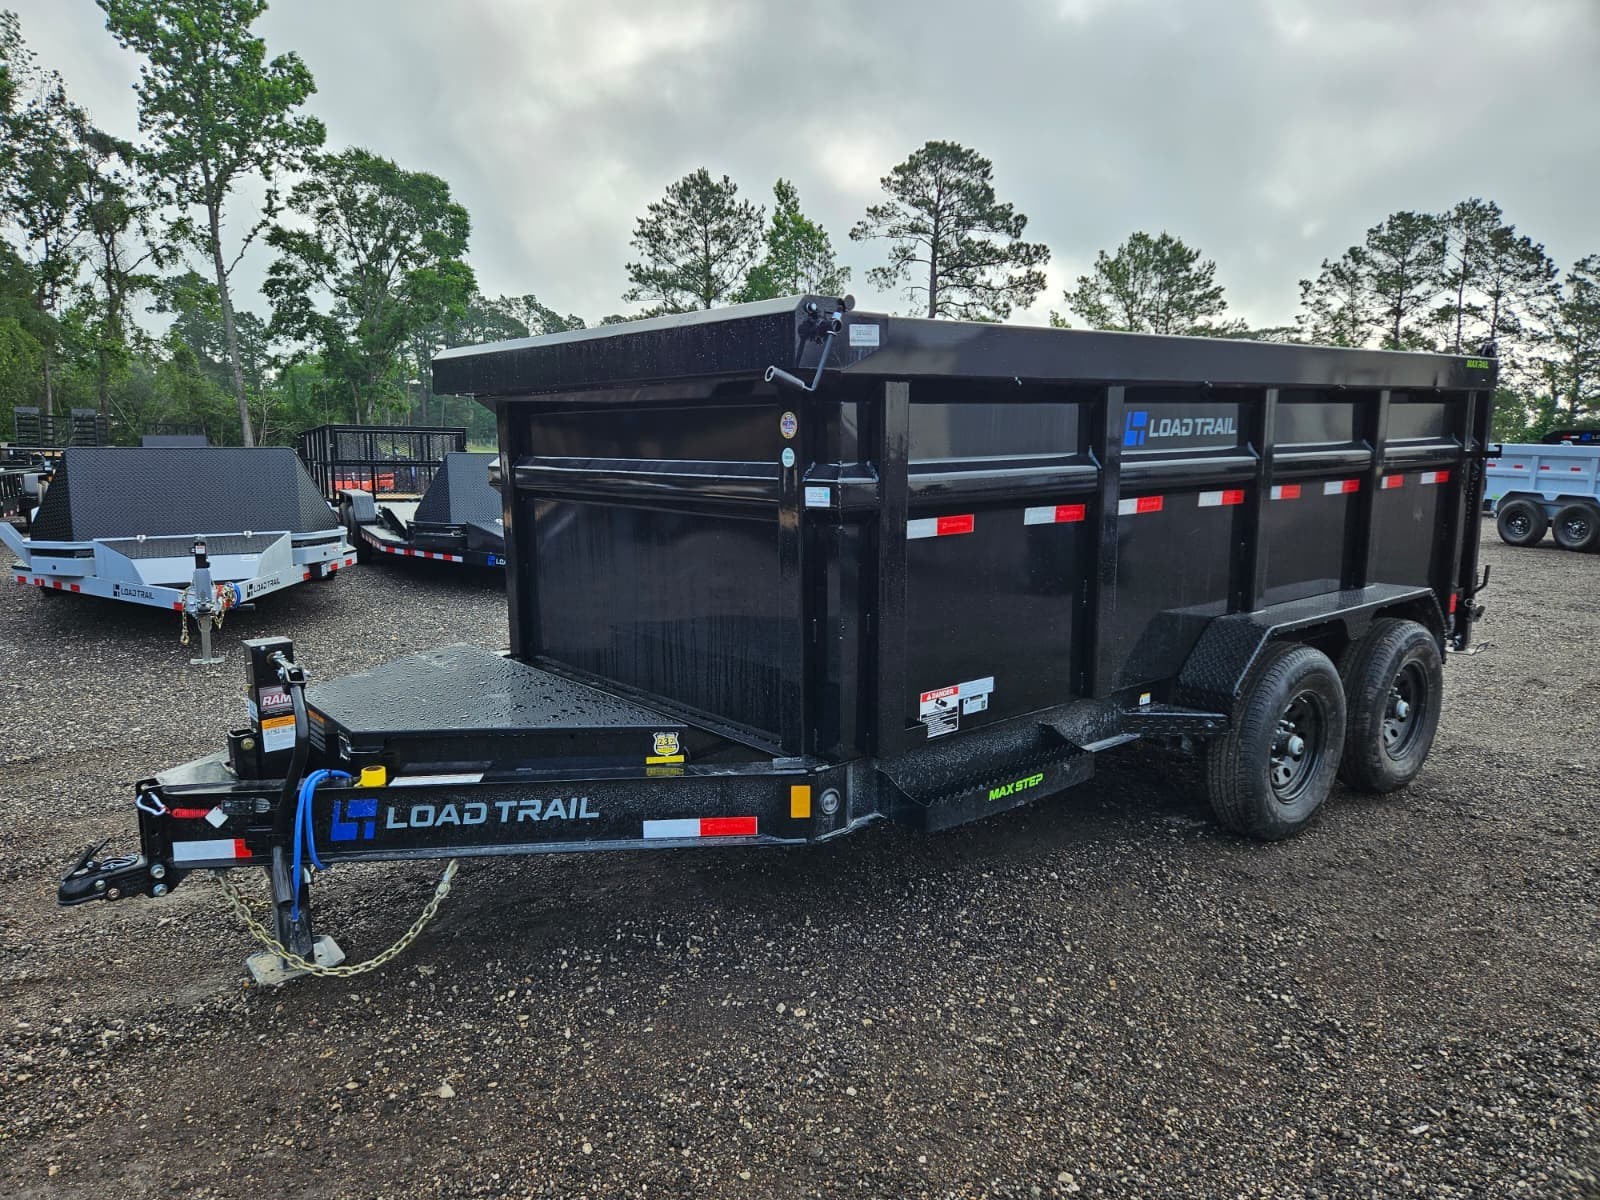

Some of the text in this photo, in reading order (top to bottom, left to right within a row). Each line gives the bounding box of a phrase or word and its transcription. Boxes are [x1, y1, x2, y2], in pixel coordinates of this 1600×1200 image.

[1149, 417, 1237, 438] LOAD TRAIL
[262, 694, 292, 706] RAM
[989, 772, 1044, 801] MAX STEP
[385, 797, 600, 829] LOAD TRAIL
